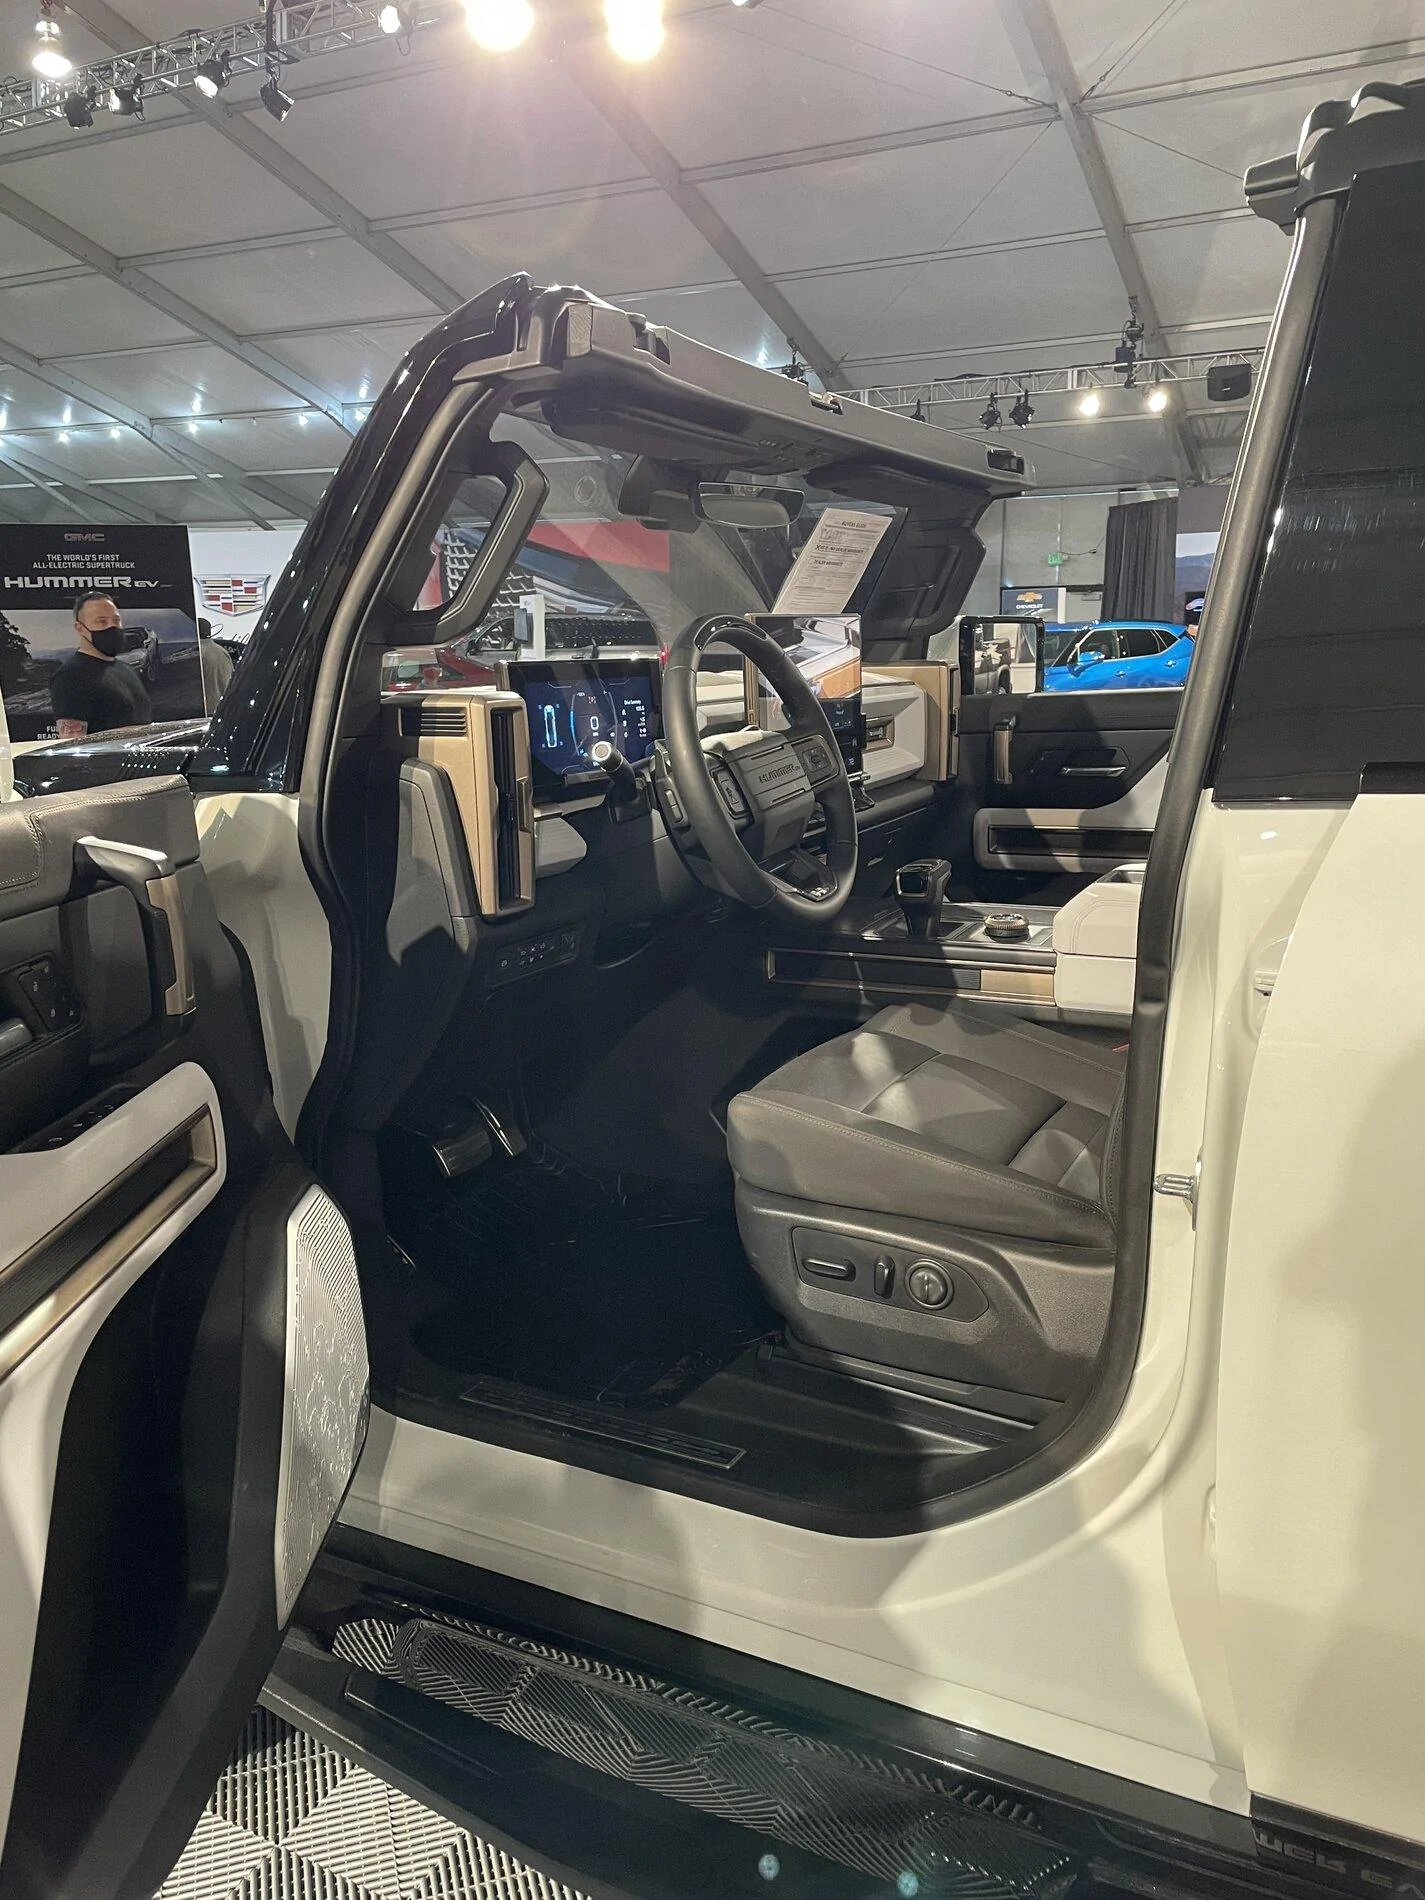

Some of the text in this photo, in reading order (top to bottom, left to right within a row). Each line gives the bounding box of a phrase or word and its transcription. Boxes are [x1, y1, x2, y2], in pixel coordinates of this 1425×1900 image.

[64, 533, 106, 542] GMC
[98, 554, 120, 562] FIRST
[4, 576, 132, 588] HUMMER
